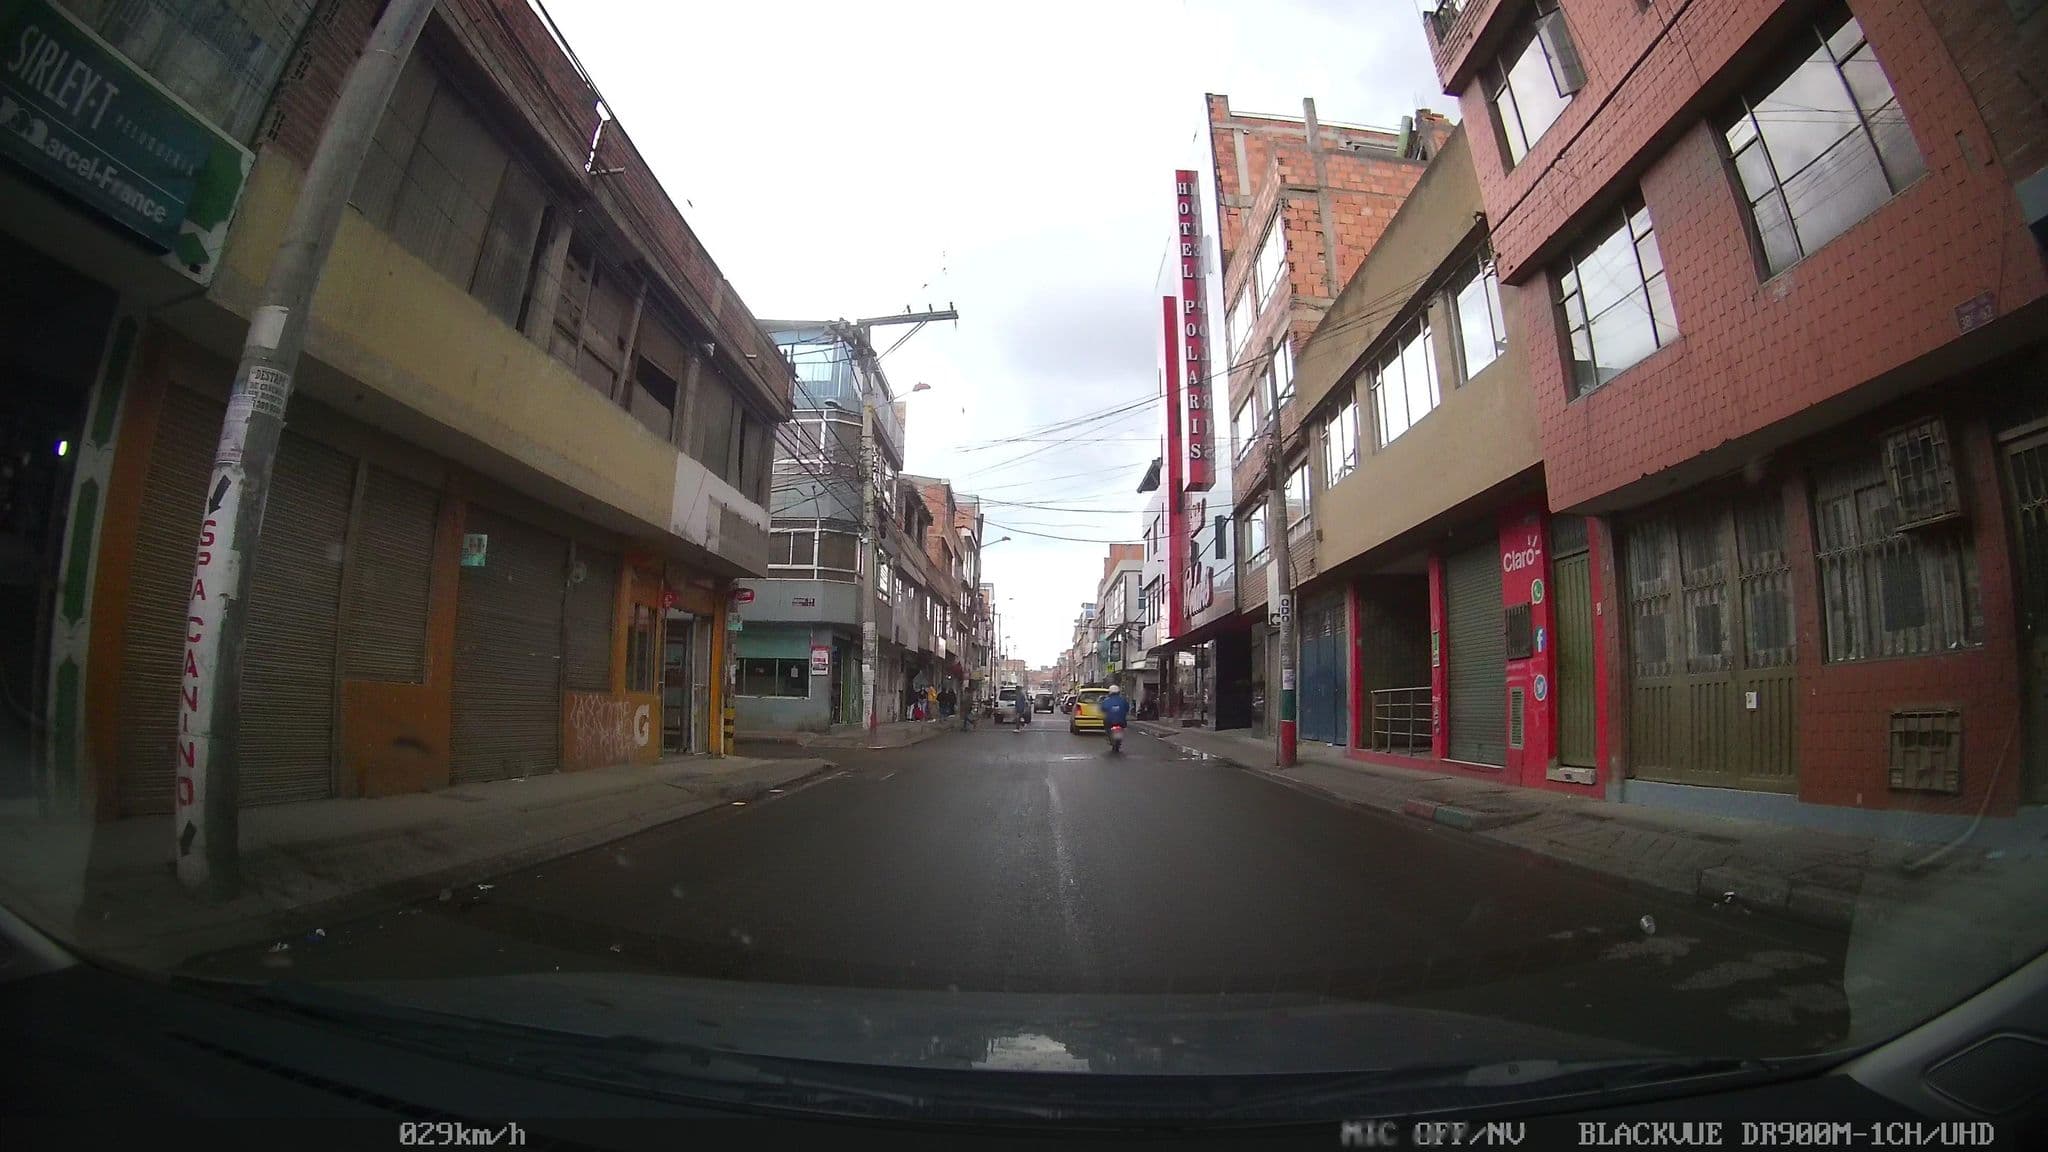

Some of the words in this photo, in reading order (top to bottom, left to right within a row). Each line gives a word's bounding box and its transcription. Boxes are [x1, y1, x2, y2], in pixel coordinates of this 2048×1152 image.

[1177, 182, 1194, 279] HOTEL
[1183, 299, 1202, 460] POLARIS
[1503, 545, 1537, 573] Claro
